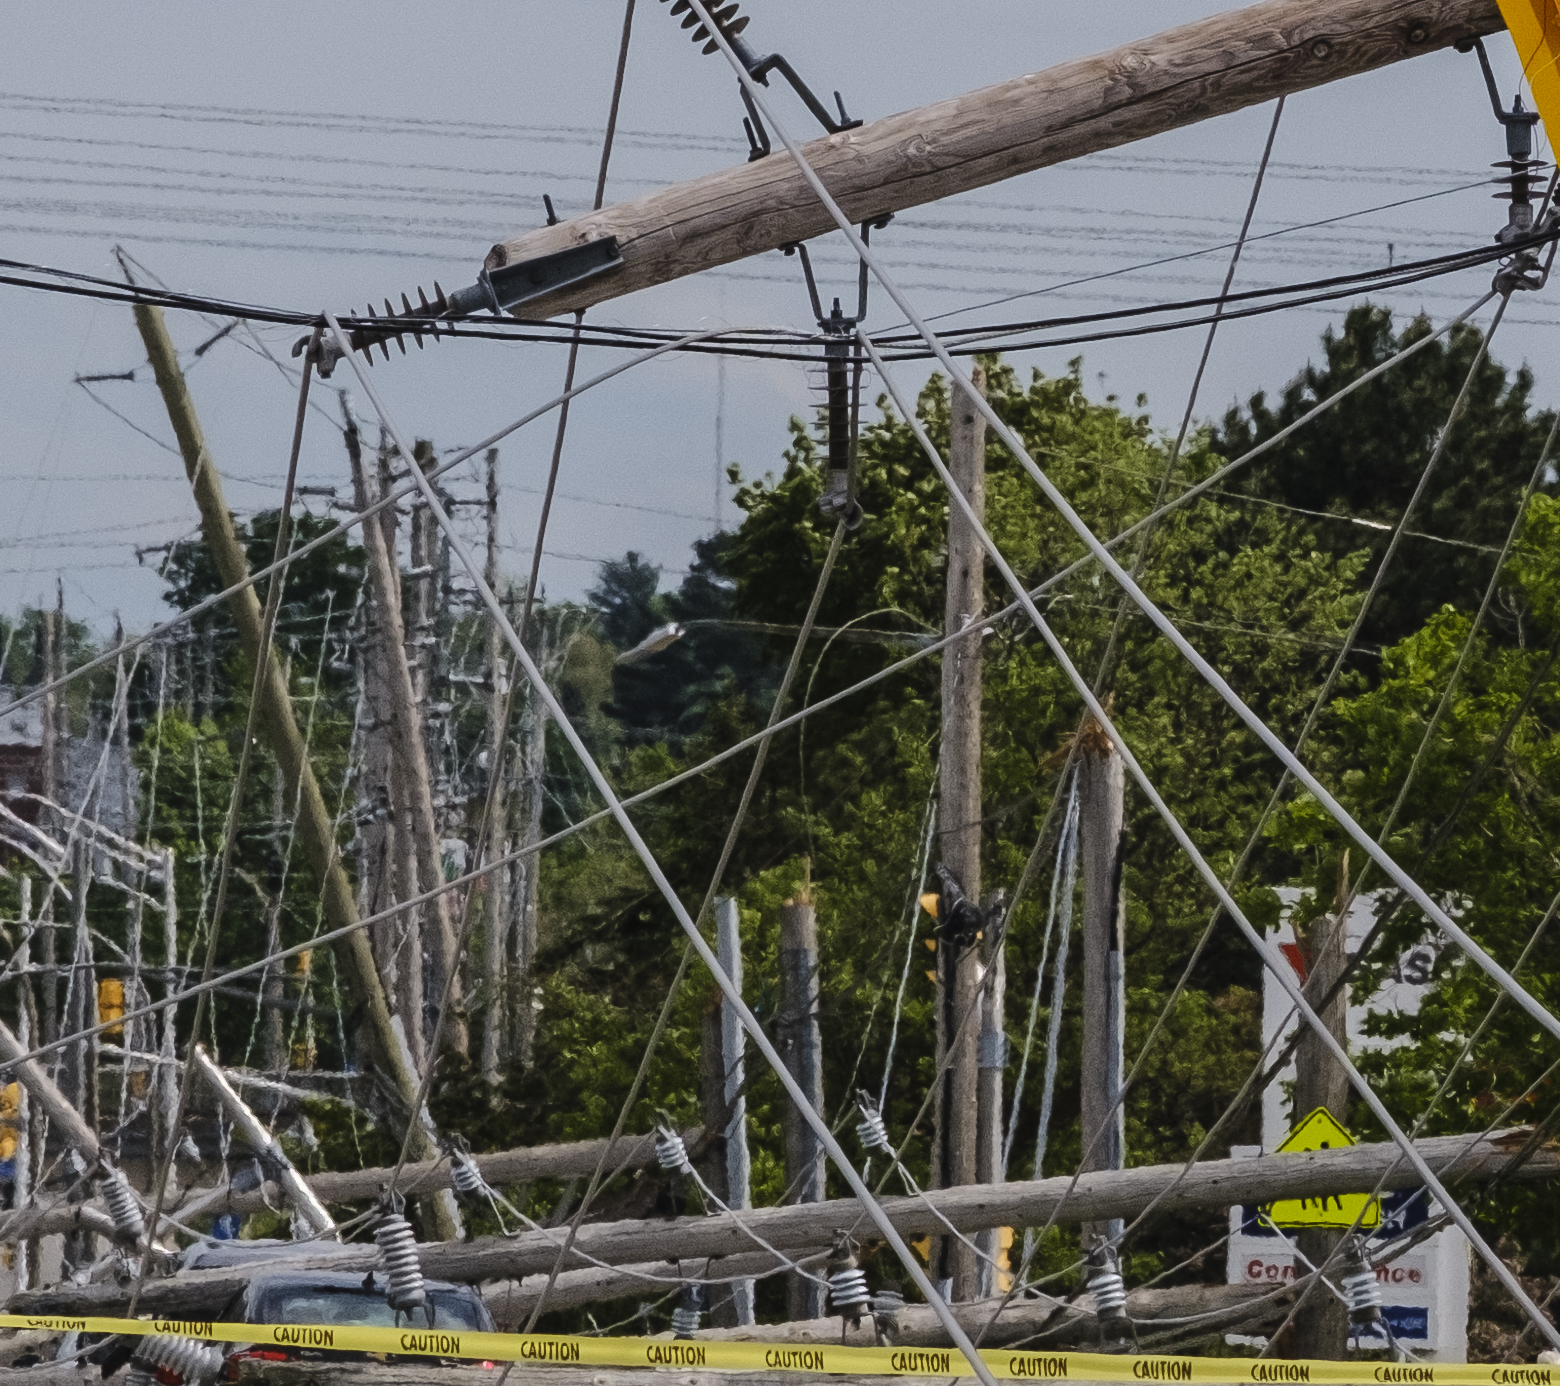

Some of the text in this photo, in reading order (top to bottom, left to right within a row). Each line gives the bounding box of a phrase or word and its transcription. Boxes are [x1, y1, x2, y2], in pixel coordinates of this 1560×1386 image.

[154, 1321, 214, 1337] CAUTION
[273, 1326, 334, 1347] CAUTION
[400, 1334, 460, 1354] CAUTION
[520, 1340, 580, 1362] CAUTION
[646, 1345, 706, 1366] CAUTION
[765, 1349, 824, 1370] CAUTION
[891, 1352, 950, 1373] CAUTION
[1009, 1356, 1068, 1377] CAUTION
[1132, 1360, 1192, 1381] CAUTION
[1250, 1363, 1310, 1382] CAUTION
[1373, 1366, 1434, 1383] CAUTION
[1491, 1368, 1552, 1386] CAUTION
